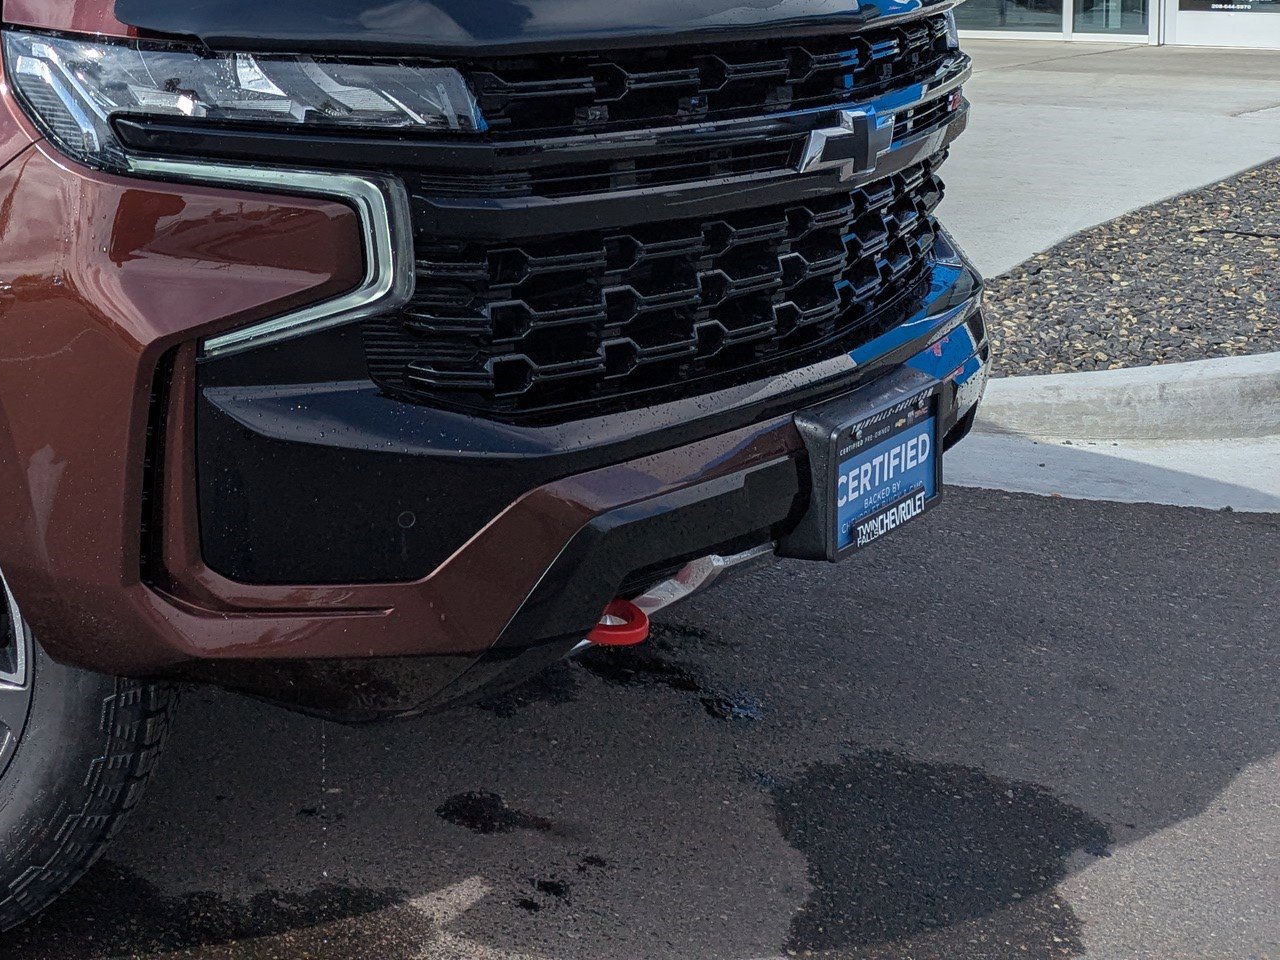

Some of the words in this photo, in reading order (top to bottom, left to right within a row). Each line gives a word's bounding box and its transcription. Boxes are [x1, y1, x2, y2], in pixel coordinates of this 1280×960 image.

[839, 439, 864, 456] CERTIFIED
[838, 434, 930, 508] CERTIFIED
[864, 486, 890, 509] BACKED
[892, 480, 902, 492] BY
[856, 517, 878, 538] TWIN
[878, 491, 926, 535] CHEVROLET
[857, 528, 878, 548] FALLS
